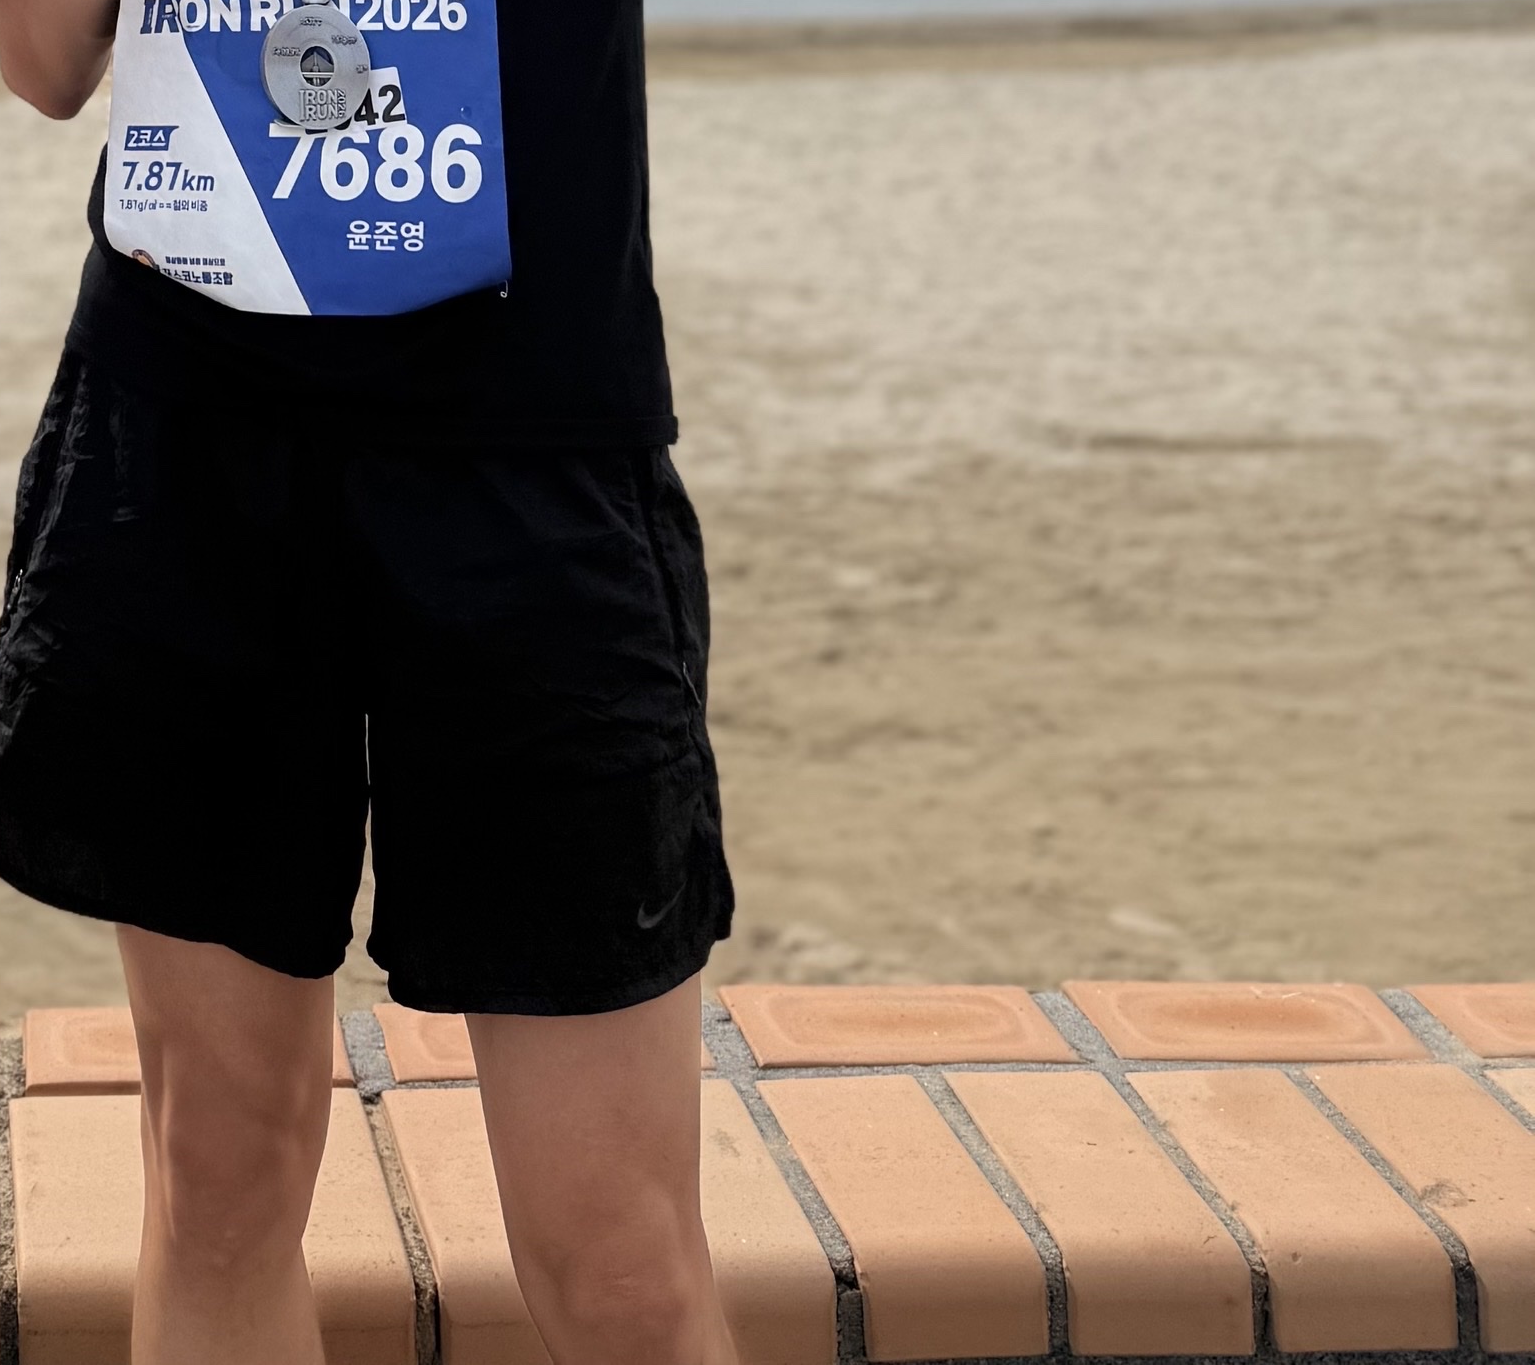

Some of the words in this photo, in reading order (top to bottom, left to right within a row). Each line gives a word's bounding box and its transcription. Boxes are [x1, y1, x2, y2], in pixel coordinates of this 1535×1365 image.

[127, 130, 166, 147] 2코스
[269, 123, 482, 203] 7686
[346, 220, 424, 252] 윤준영
